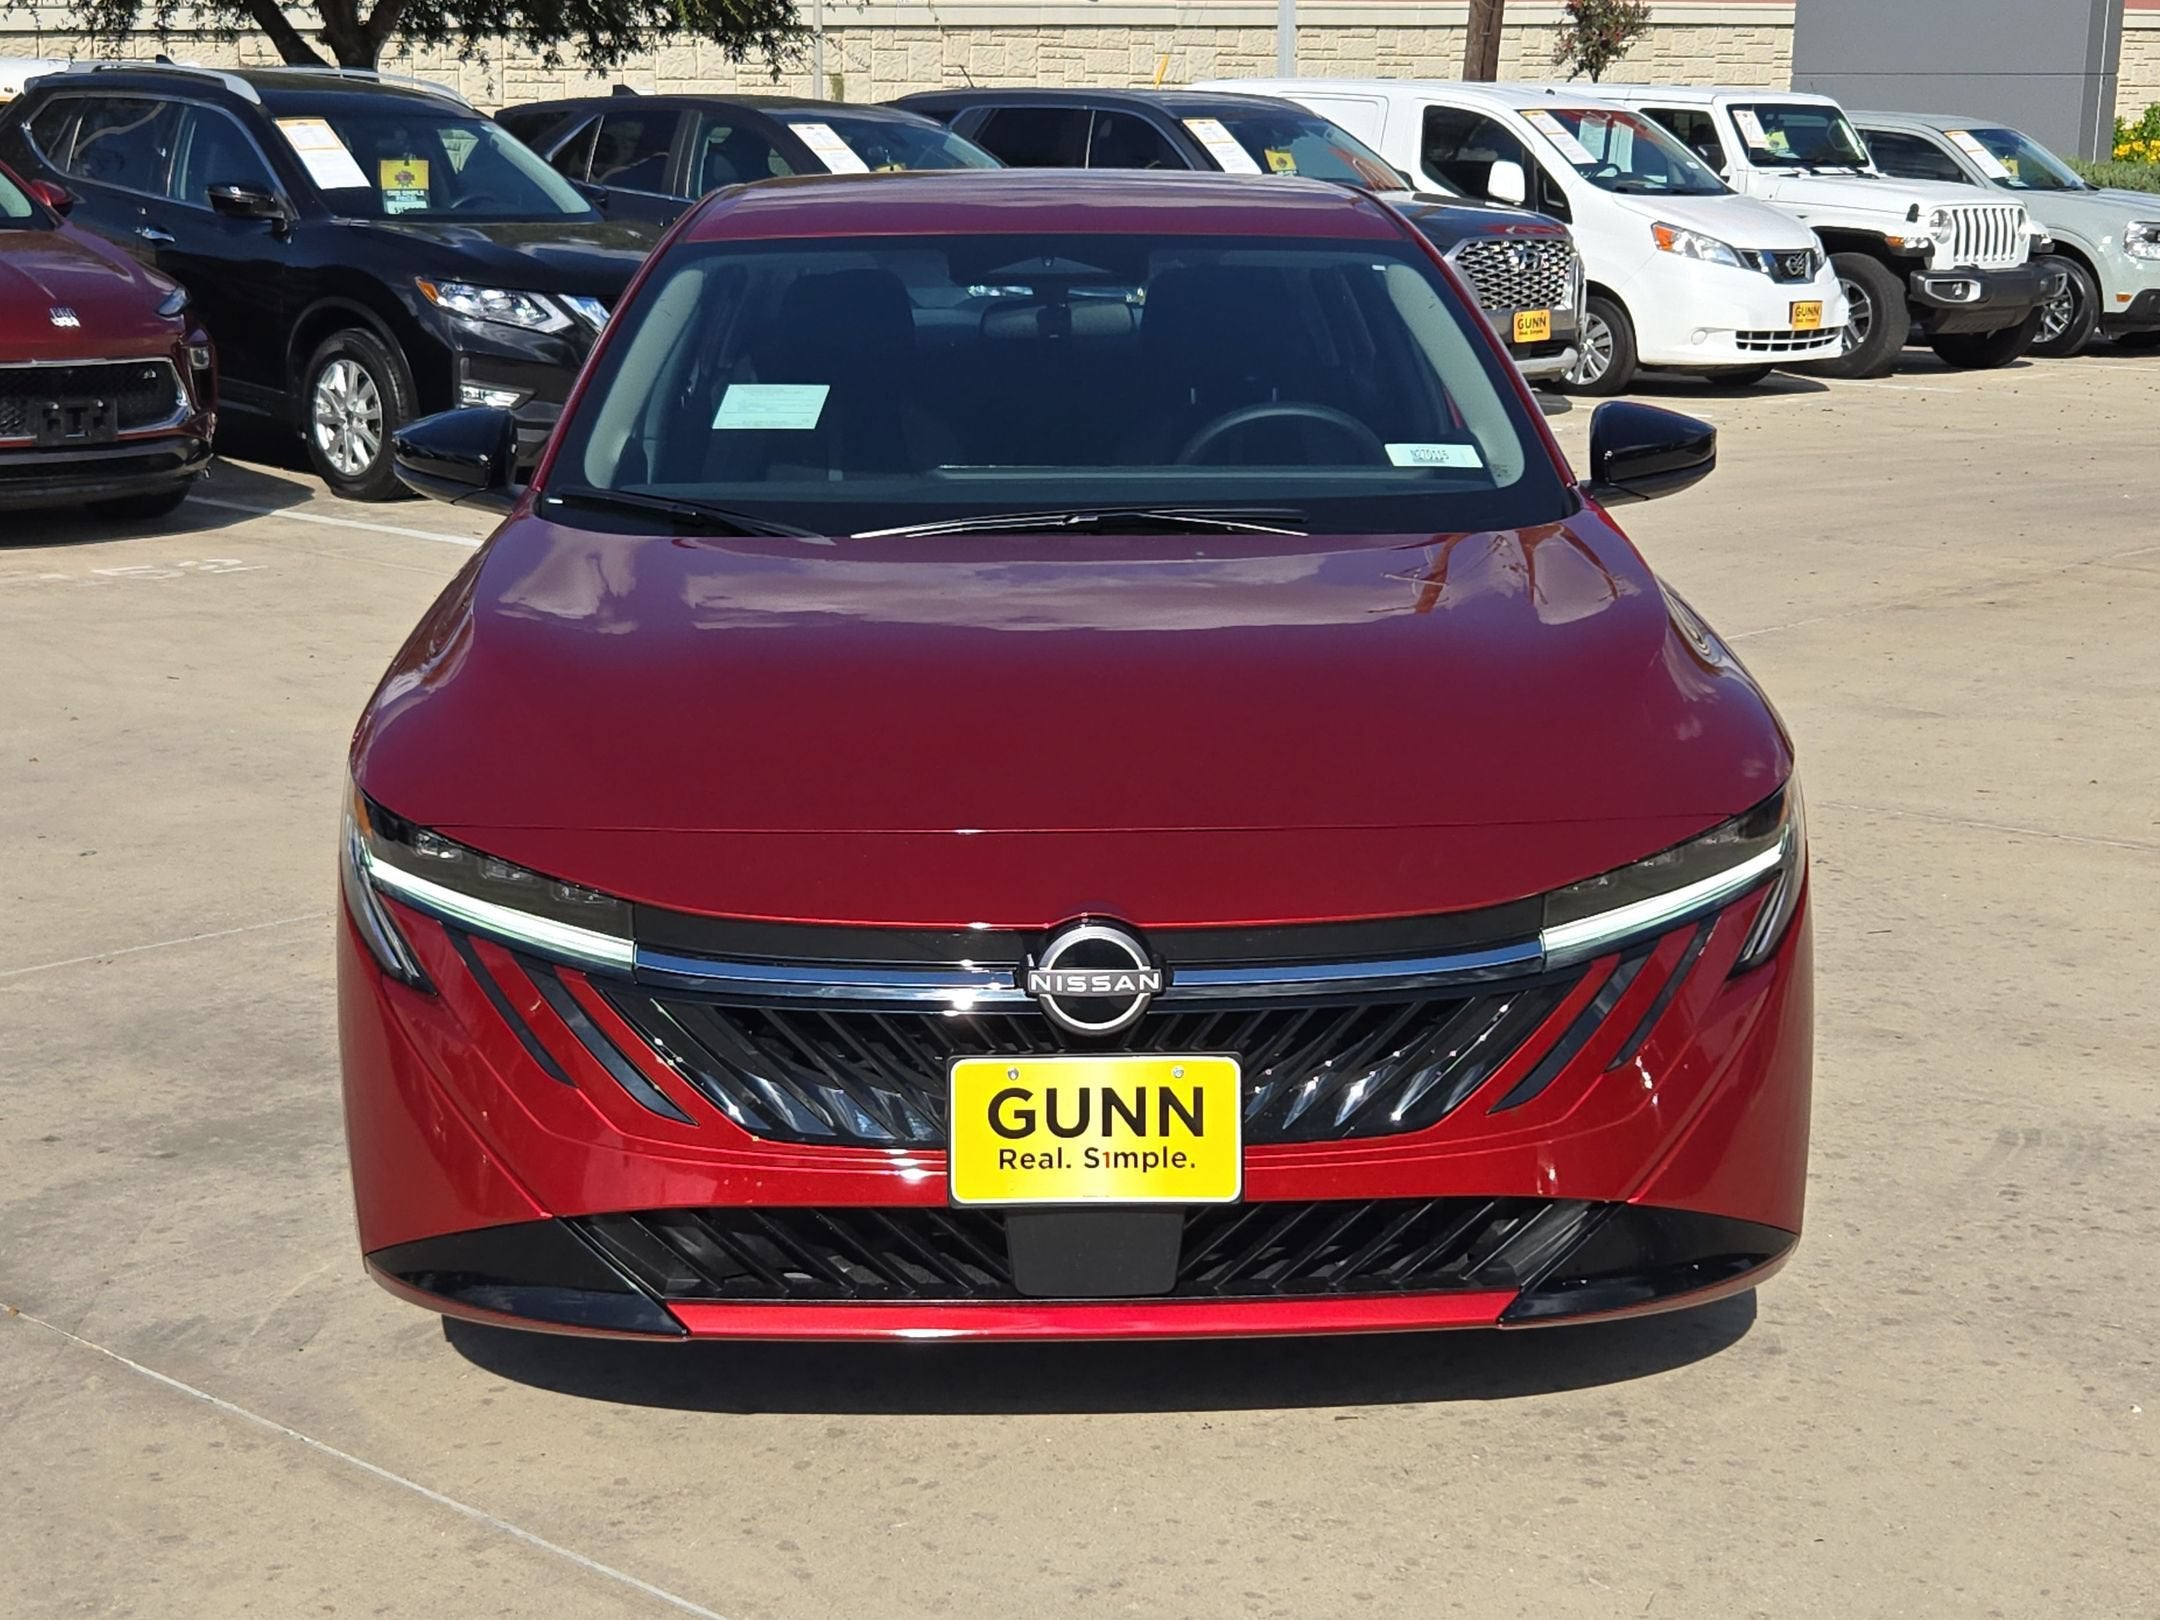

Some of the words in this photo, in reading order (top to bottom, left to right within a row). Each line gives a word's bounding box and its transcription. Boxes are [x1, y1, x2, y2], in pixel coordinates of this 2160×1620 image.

[1517, 316, 1546, 330] GUNN
[1031, 973, 1159, 992] NISSAN
[987, 1086, 1204, 1140] GUNN
[998, 1146, 1072, 1170] Real.
